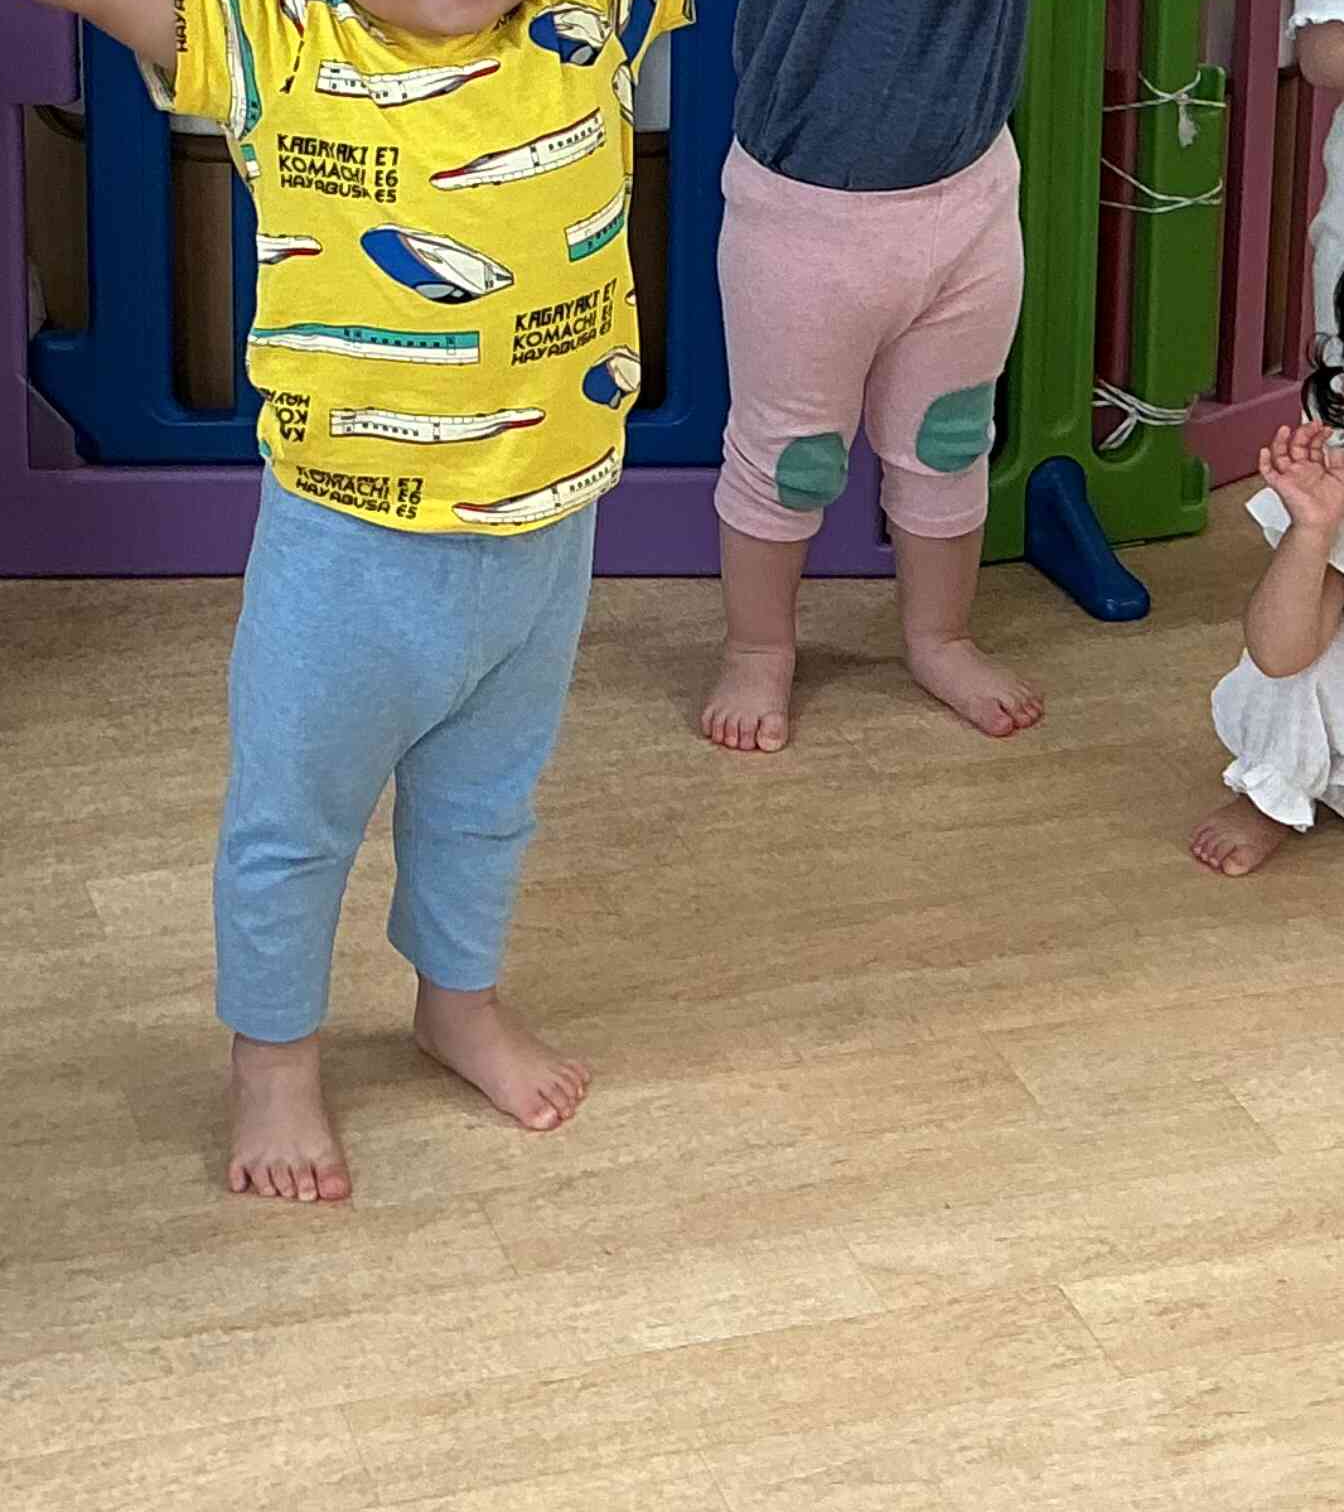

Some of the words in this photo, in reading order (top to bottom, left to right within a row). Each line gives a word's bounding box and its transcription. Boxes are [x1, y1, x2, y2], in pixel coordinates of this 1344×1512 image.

[375, 146, 399, 167] E7
[374, 169, 399, 188] E6
[374, 188, 397, 204] E5
[515, 289, 600, 332] KAGAYAKI
[513, 310, 597, 353] KOMACHI
